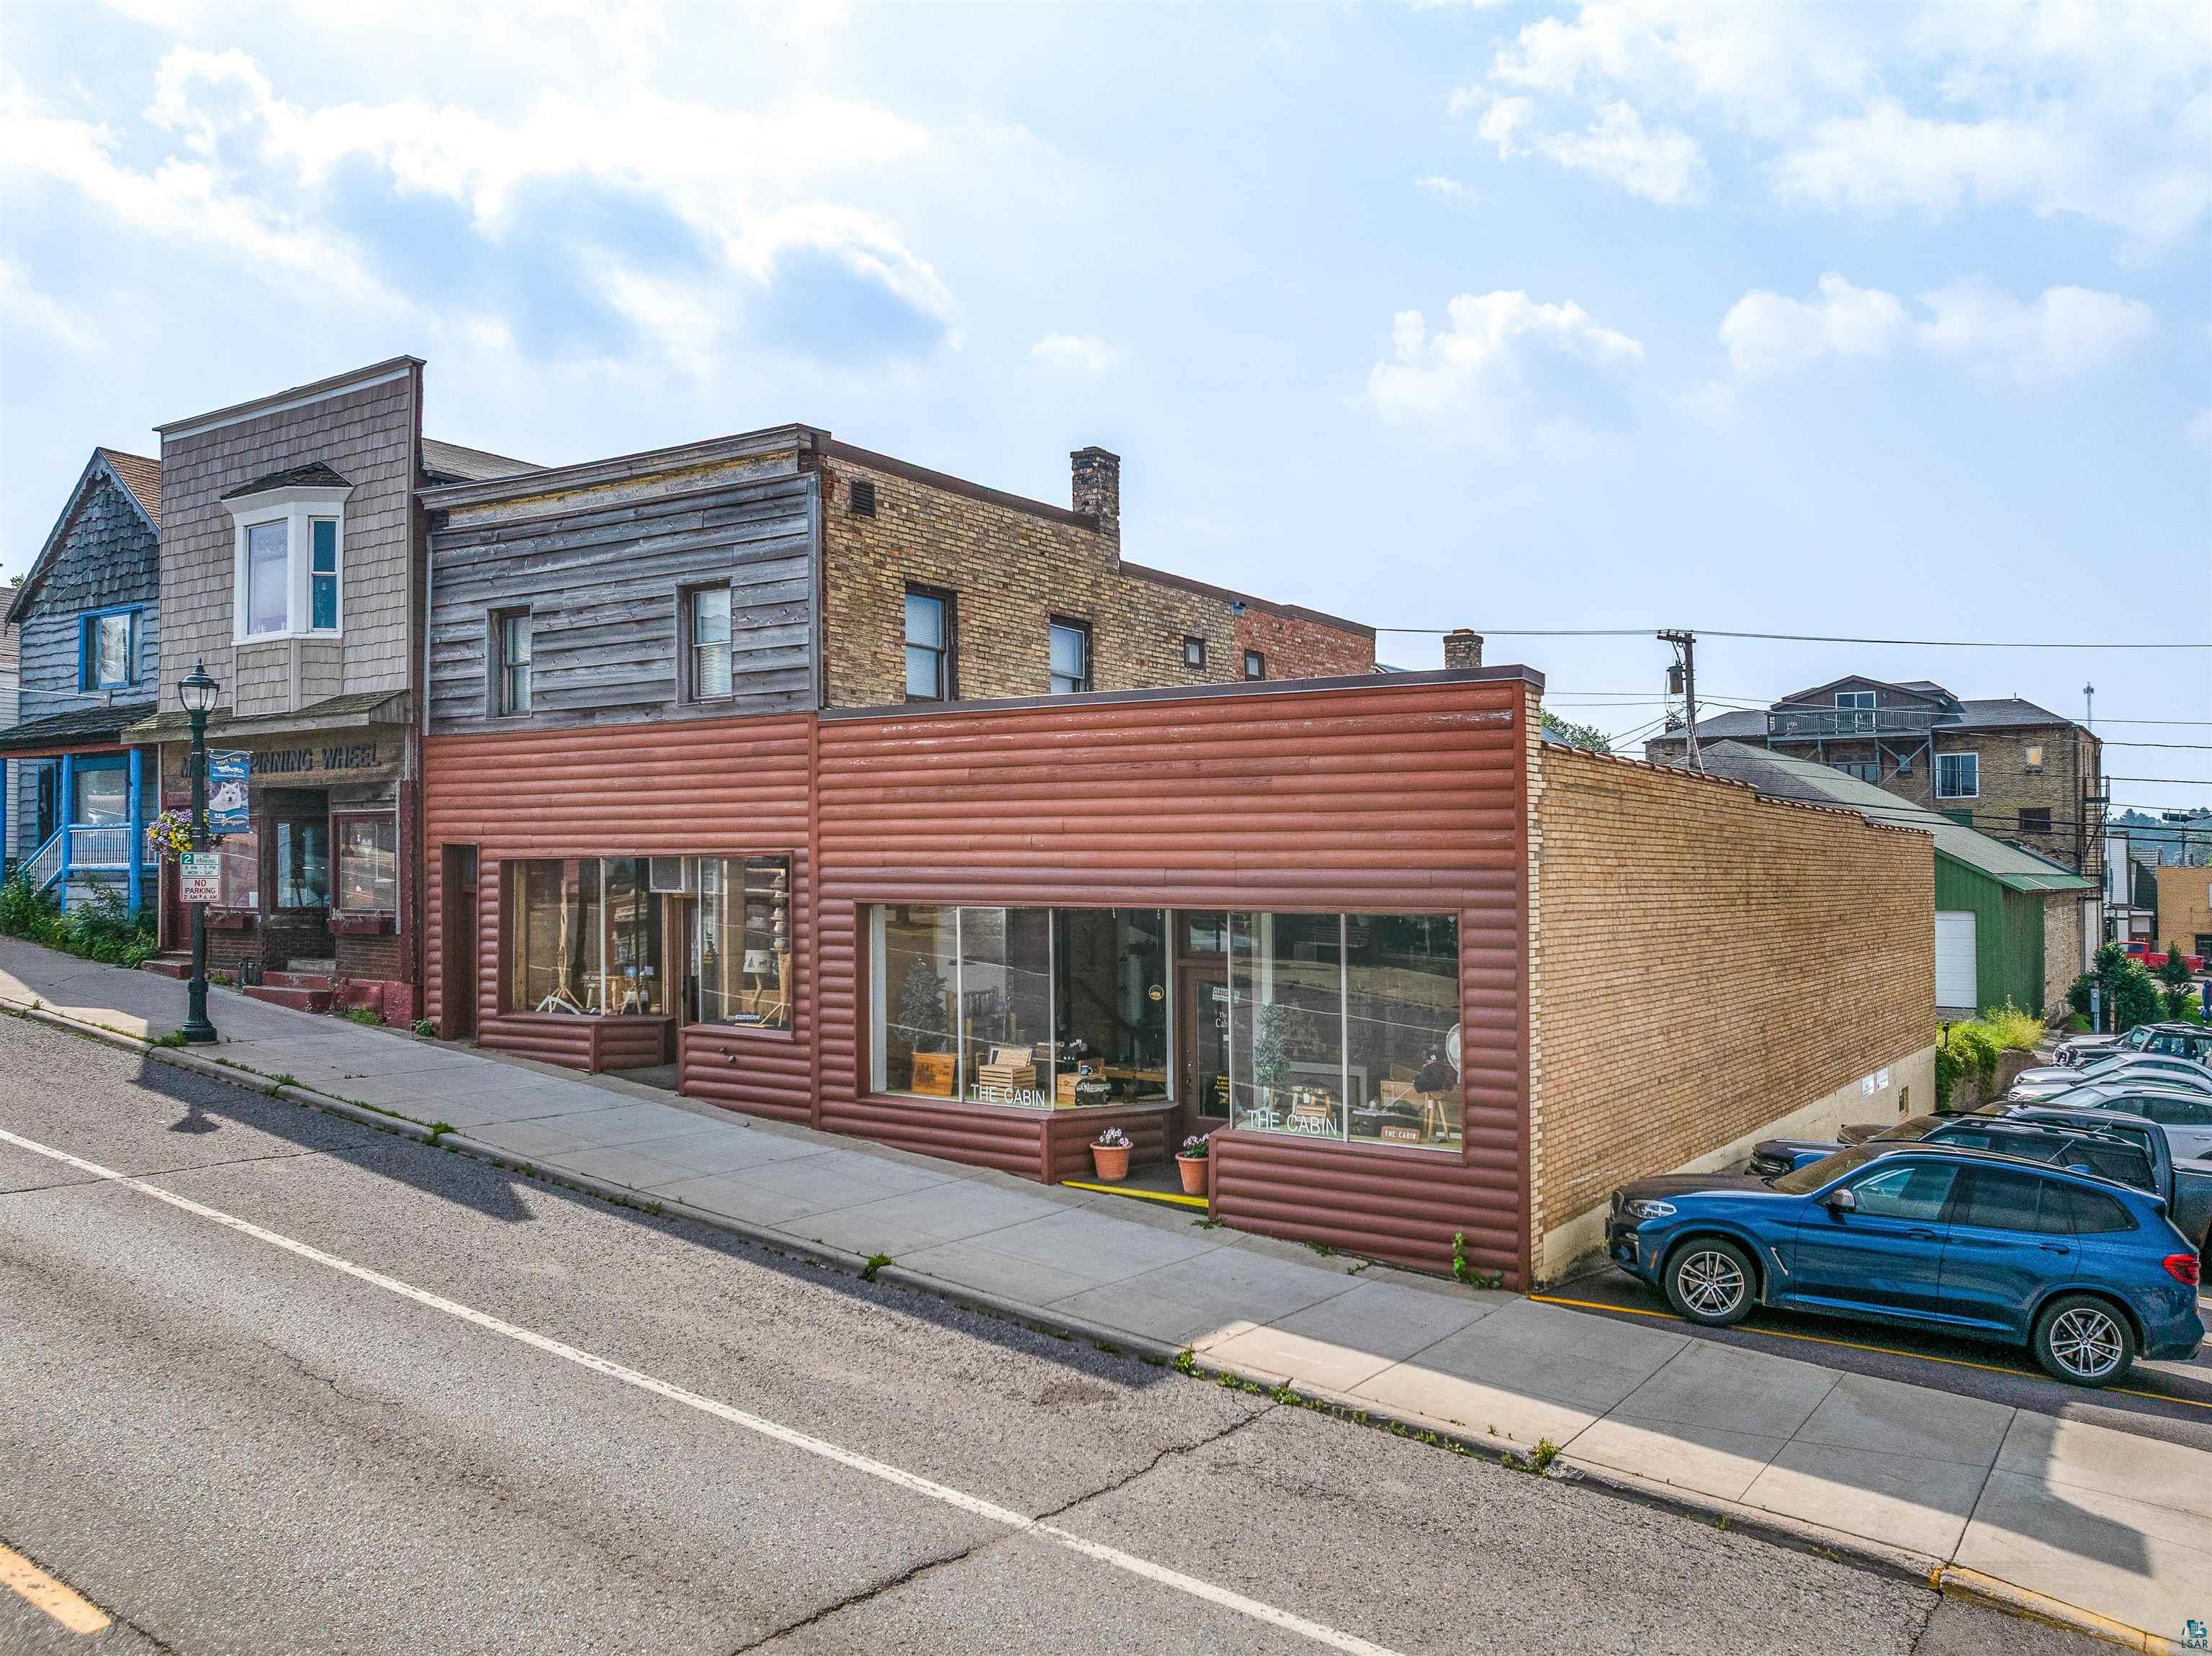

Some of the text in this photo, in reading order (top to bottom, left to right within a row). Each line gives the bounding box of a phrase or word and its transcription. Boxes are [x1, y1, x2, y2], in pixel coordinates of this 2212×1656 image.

[323, 744, 379, 769] WHEEL
[184, 854, 192, 864] 2
[1215, 1018, 1228, 1028] Cab
[1080, 1082, 1107, 1094] Welcome
[971, 1084, 1045, 1107] THE CABIN
[1247, 1110, 1337, 1135] THE CABIN
[1398, 1131, 1417, 1140] CABIN
